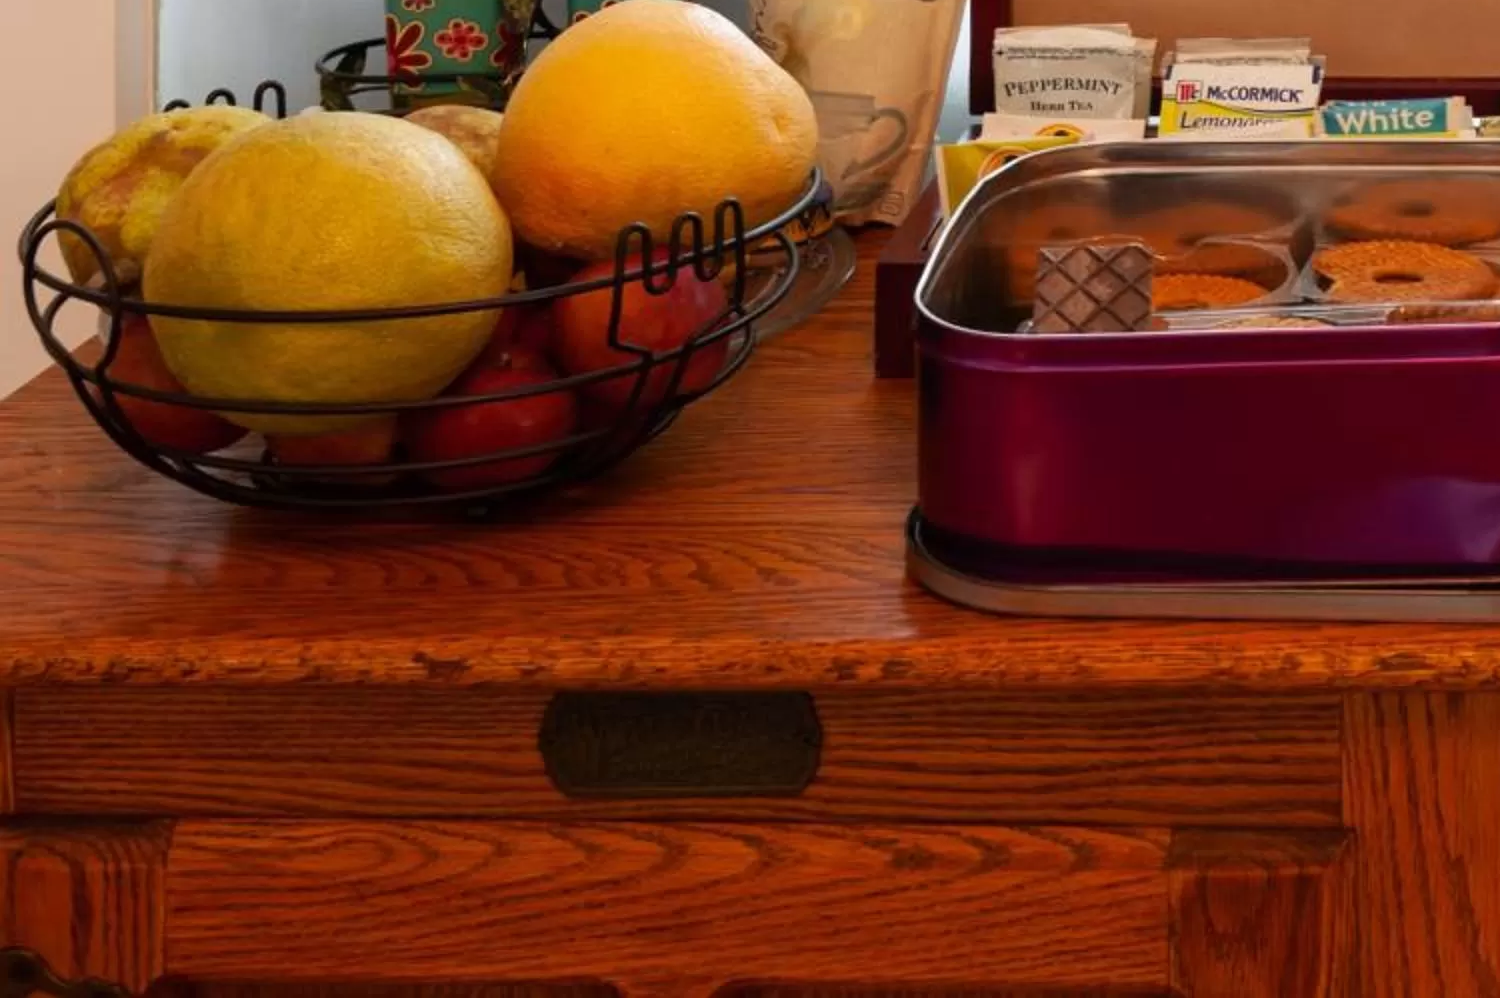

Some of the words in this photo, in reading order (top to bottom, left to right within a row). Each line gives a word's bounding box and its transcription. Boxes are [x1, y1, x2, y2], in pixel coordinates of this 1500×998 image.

[1004, 77, 1123, 97] PEPPERMINT
[1206, 85, 1301, 103] McCORMICK
[1336, 108, 1435, 135] White
